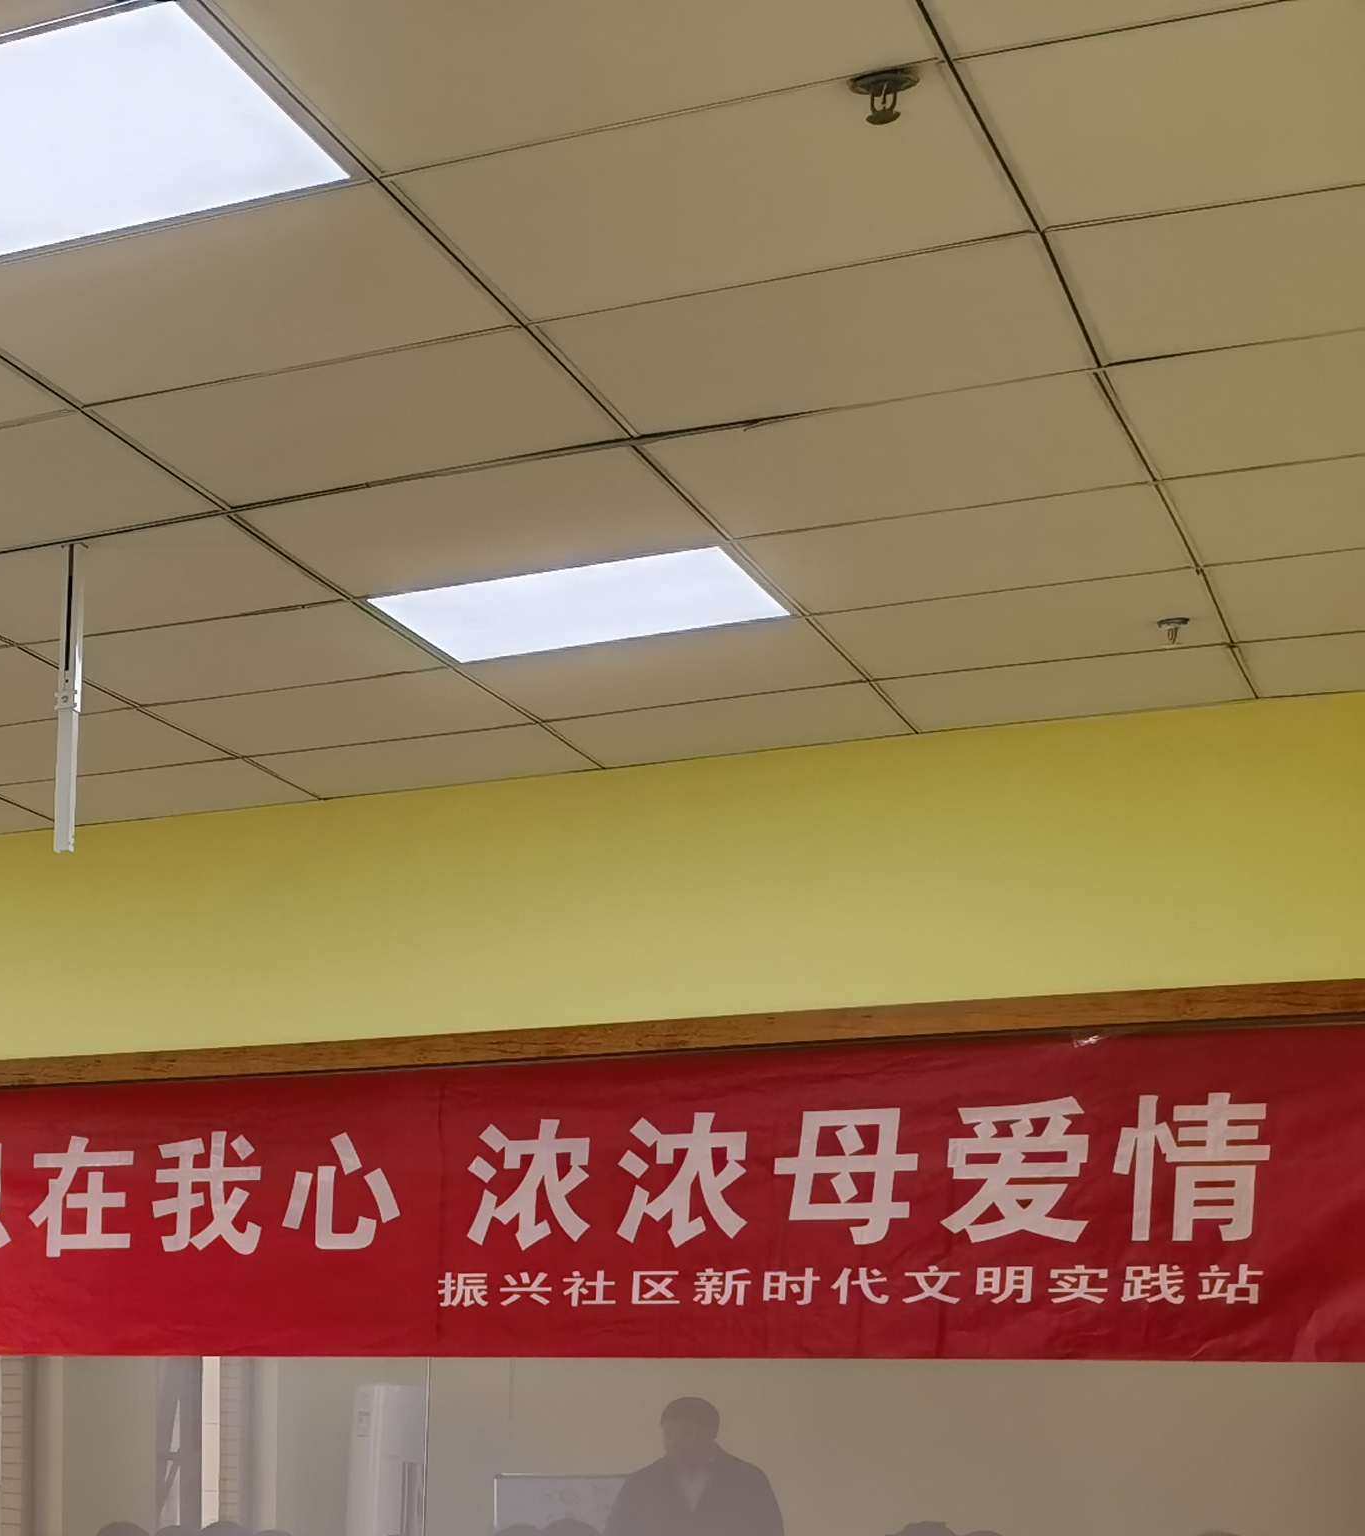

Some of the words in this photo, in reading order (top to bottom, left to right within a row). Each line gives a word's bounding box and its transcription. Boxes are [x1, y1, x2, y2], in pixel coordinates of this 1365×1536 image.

[466, 1091, 1272, 1251] 浓浓母爱情
[437, 1263, 1266, 1308] 振兴社区新时代文明实践站
